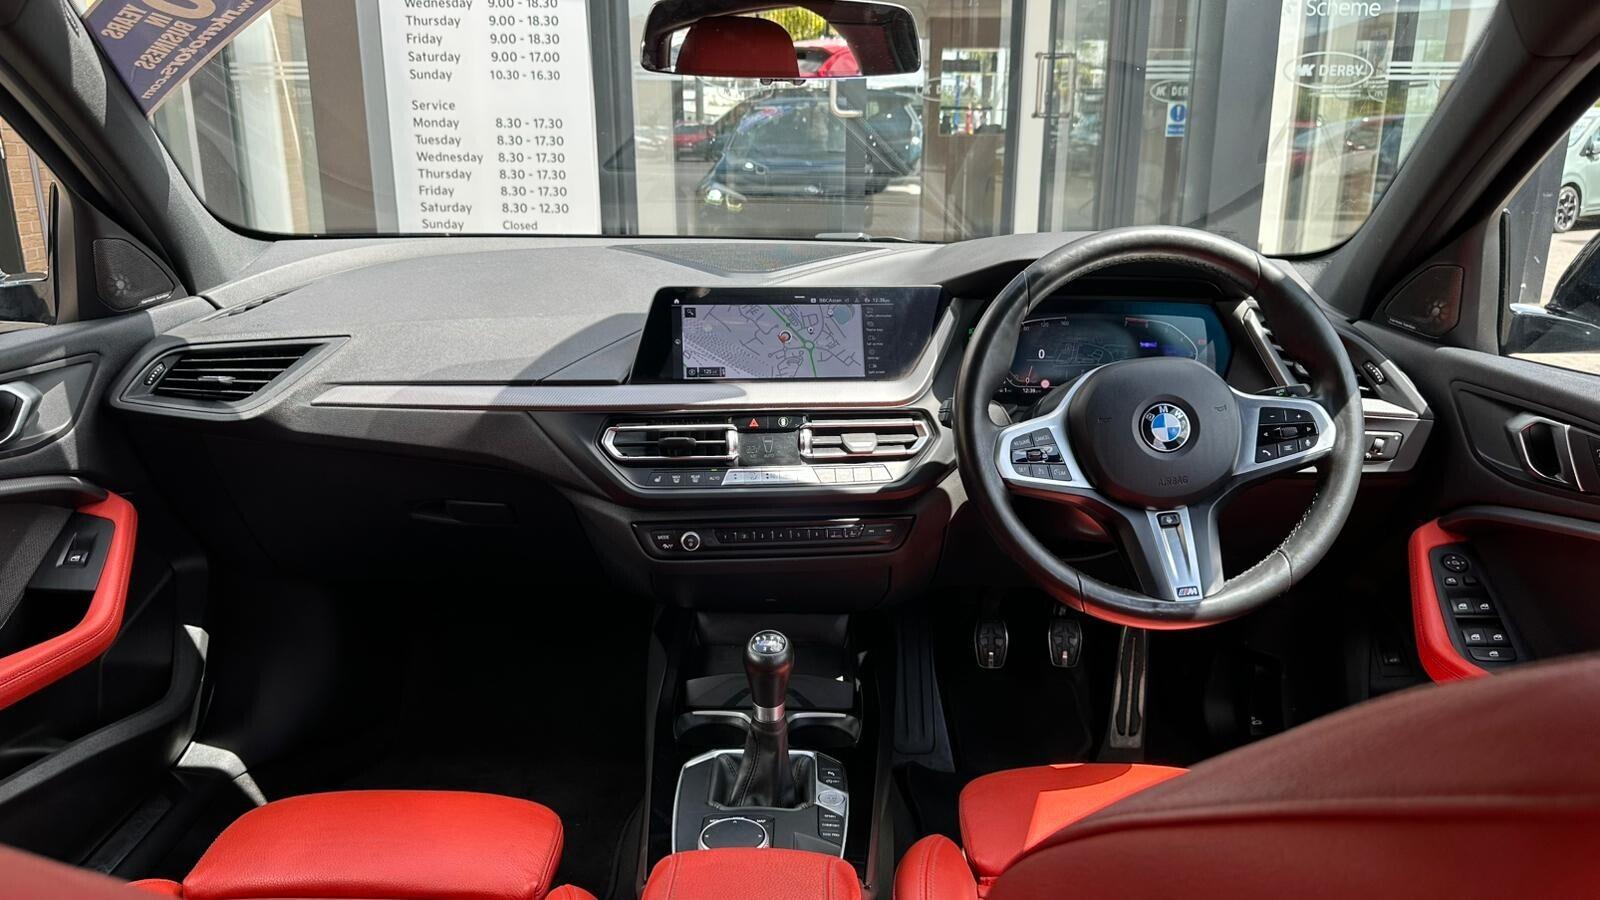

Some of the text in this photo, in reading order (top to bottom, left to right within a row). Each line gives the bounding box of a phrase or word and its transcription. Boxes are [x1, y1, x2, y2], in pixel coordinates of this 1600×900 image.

[404, 0, 474, 11] Wednesday
[487, 0, 514, 9] 9.00
[527, 0, 559, 9] 18.30
[1306, 0, 1382, 17] Scheme
[405, 15, 462, 28] Thursday
[488, 15, 516, 26] 9.00
[527, 15, 560, 26] 18.30
[406, 33, 443, 46] Friday
[490, 33, 517, 45] 9.00
[529, 33, 561, 45] 18.30
[408, 51, 462, 64] Saturday
[491, 51, 518, 63] 9.00
[530, 51, 561, 63] 17.00
[410, 69, 453, 82] Sunday
[490, 69, 520, 81] 10.30
[531, 69, 561, 81] 16.30
[1319, 64, 1364, 77] DERBY
[412, 100, 456, 111] Service
[413, 117, 461, 130] Monday
[495, 117, 522, 129] 8.30
[534, 118, 564, 129] 17.30
[415, 134, 463, 147] Tuesday
[497, 134, 523, 146] 8.30
[535, 135, 565, 146] 17.30
[416, 151, 485, 164] Wednesday
[498, 151, 525, 163] 8.30
[536, 152, 566, 163] 17.30
[418, 168, 473, 181] Thursday
[499, 168, 526, 180] 8.30
[537, 169, 567, 180] 17.30
[419, 185, 456, 198] Friday
[500, 185, 527, 197] 8.30
[538, 186, 568, 197] 17.30
[420, 202, 473, 215] Saturday
[502, 202, 528, 214] 8.30
[539, 203, 570, 214] 12.30
[422, 219, 538, 231] Sunday Closed
[1038, 348, 1046, 360] 0
[1145, 405, 1184, 422] BMW
[1158, 475, 1189, 487] AIRBAG
